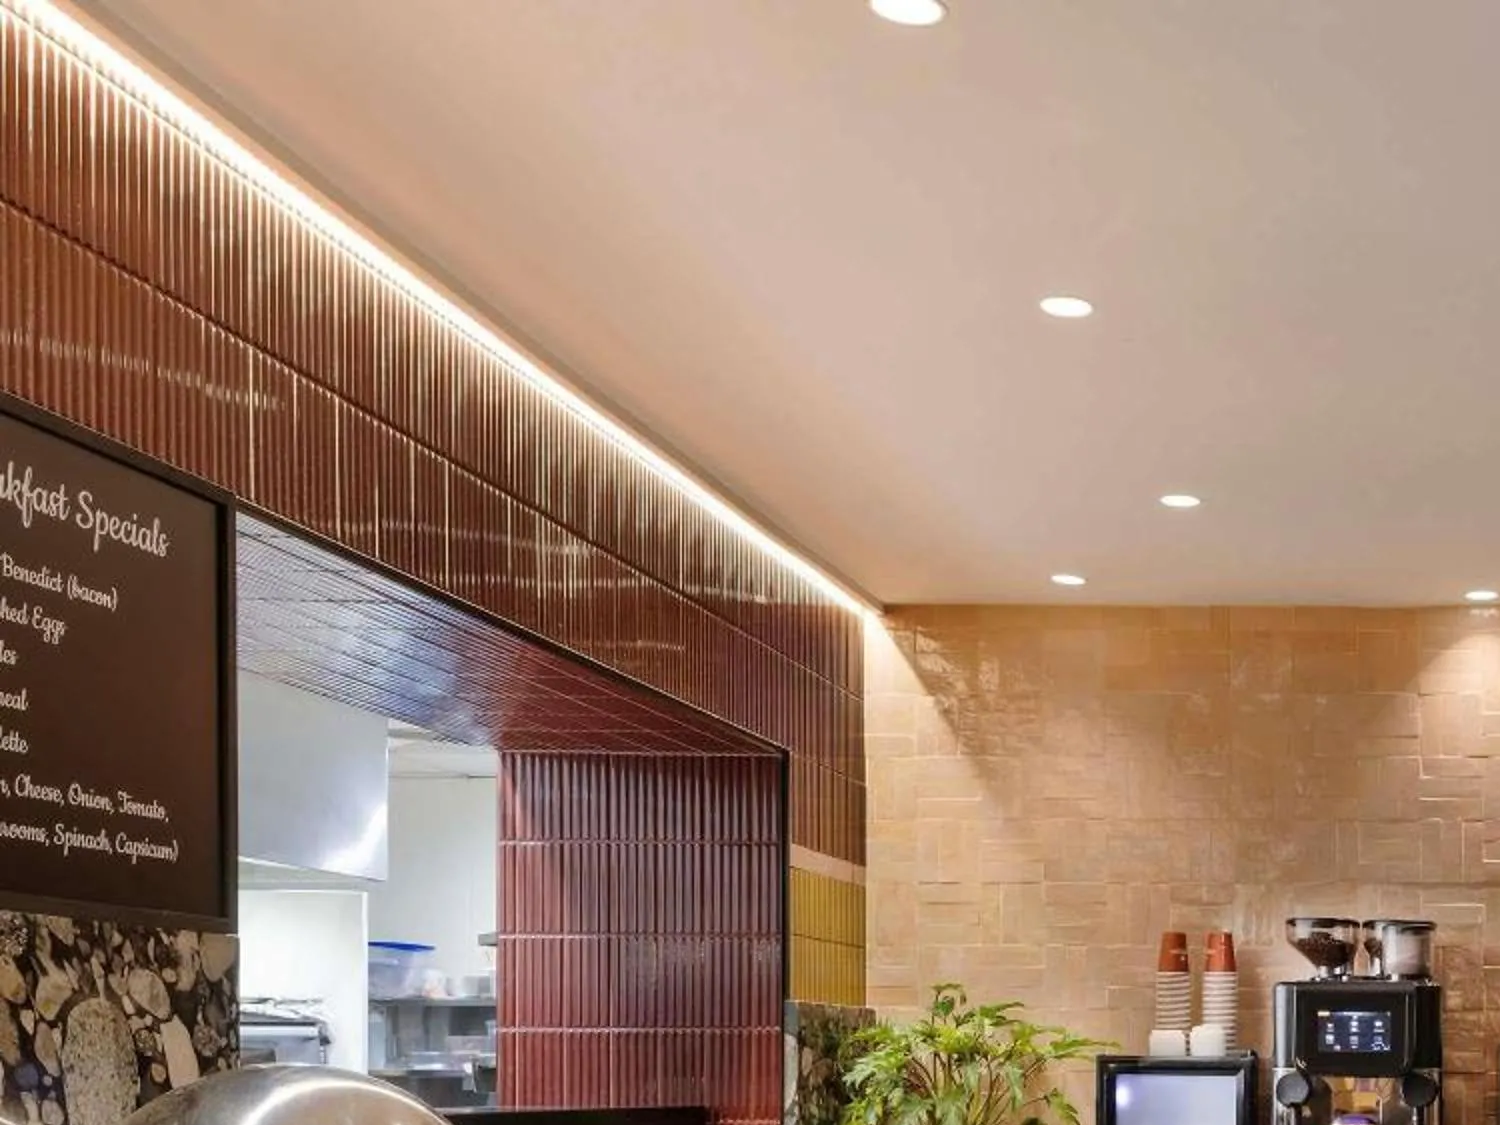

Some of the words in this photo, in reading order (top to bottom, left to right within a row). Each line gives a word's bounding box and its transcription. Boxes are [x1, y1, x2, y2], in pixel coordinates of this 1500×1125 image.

[75, 490, 170, 557] Specials
[0, 552, 64, 593] Benedict
[67, 574, 119, 612] (bacon)
[31, 605, 69, 645] Eggs
[15, 773, 65, 807] Cheese,
[68, 783, 115, 815] Onion,
[117, 790, 169, 823] Tomato,
[53, 823, 112, 857] Spinach,
[115, 832, 179, 865] Capsicum)
